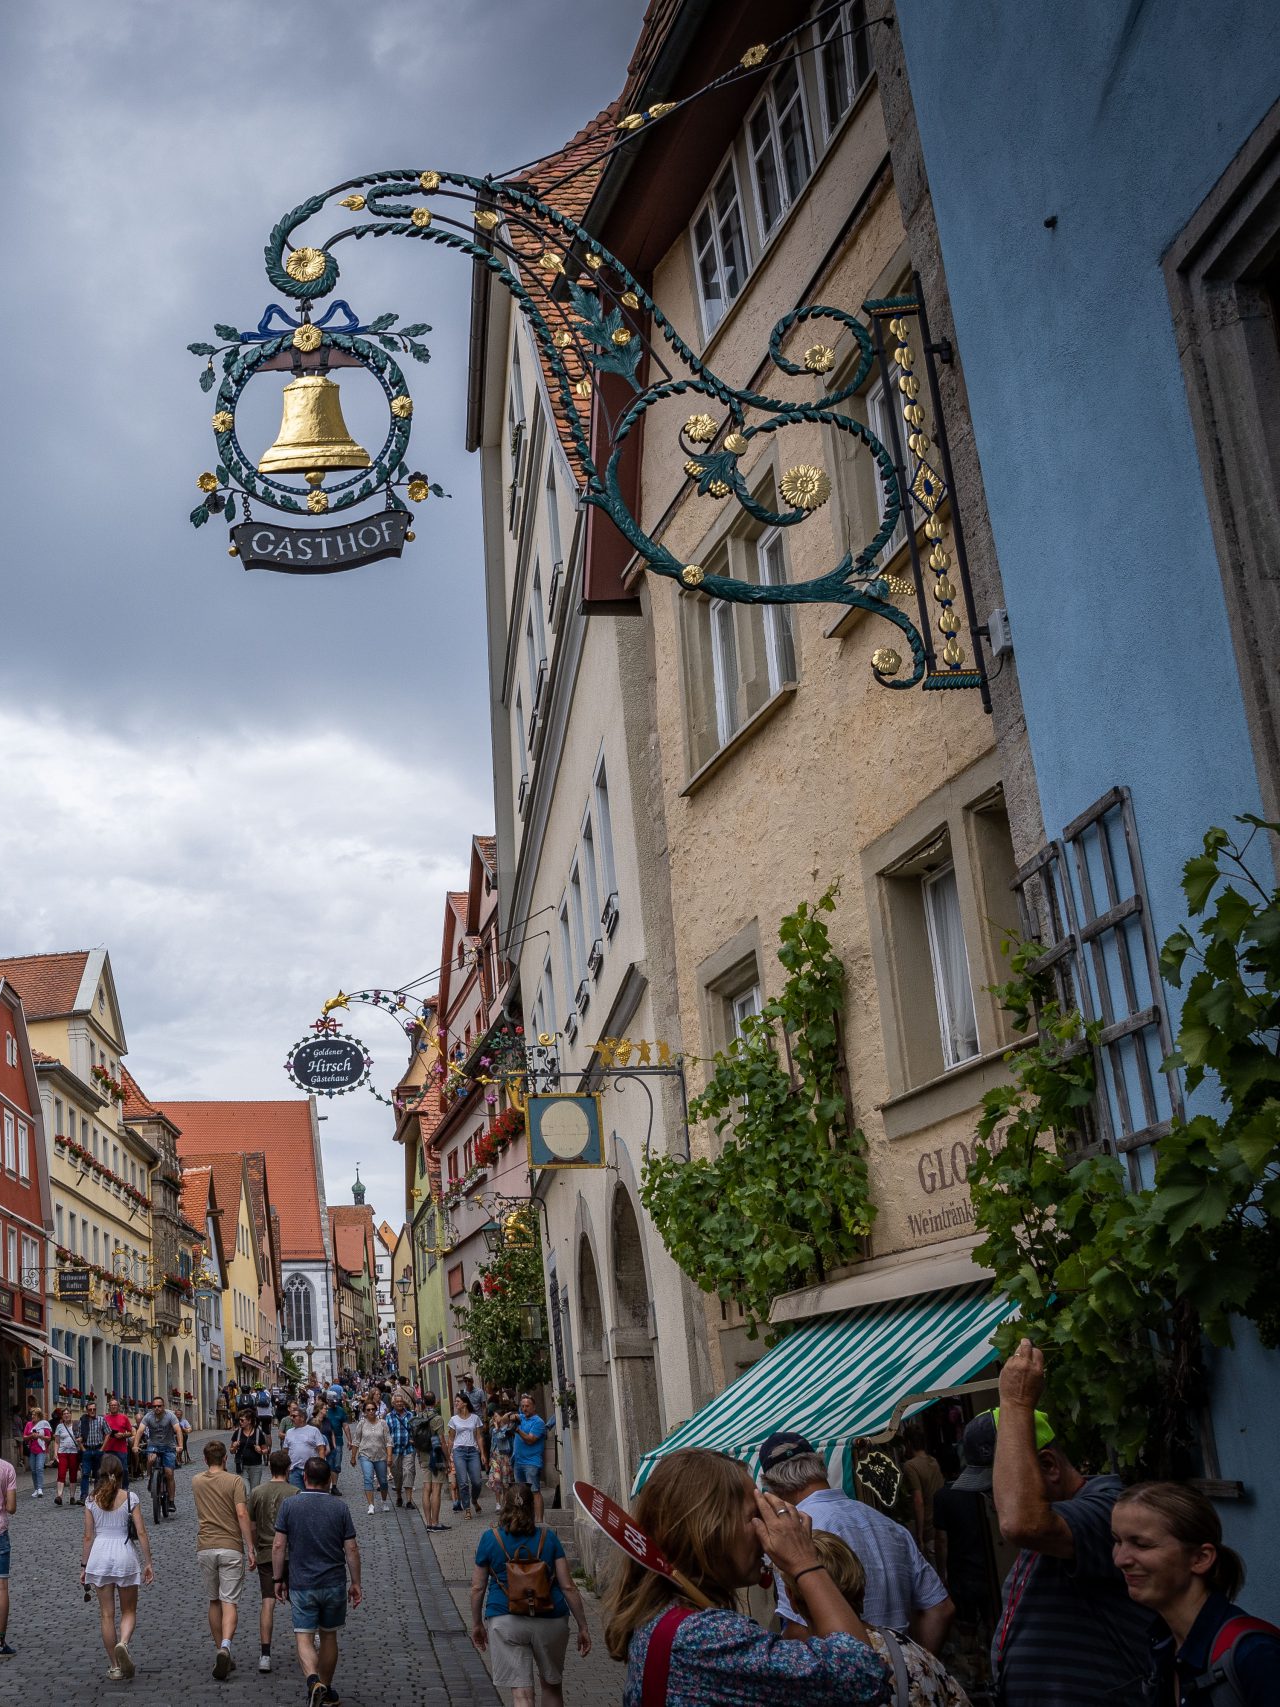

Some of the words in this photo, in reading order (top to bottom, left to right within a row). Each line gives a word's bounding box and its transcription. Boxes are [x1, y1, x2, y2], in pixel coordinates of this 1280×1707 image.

[251, 520, 394, 560] GASTHOF
[307, 1057, 352, 1073] Hirsch
[313, 1047, 344, 1058] Goldener
[310, 1073, 349, 1085] Gästehaus
[917, 1126, 1007, 1195] GLO
[591, 1490, 605, 1520] VIKING
[624, 1522, 647, 1557] 43A
